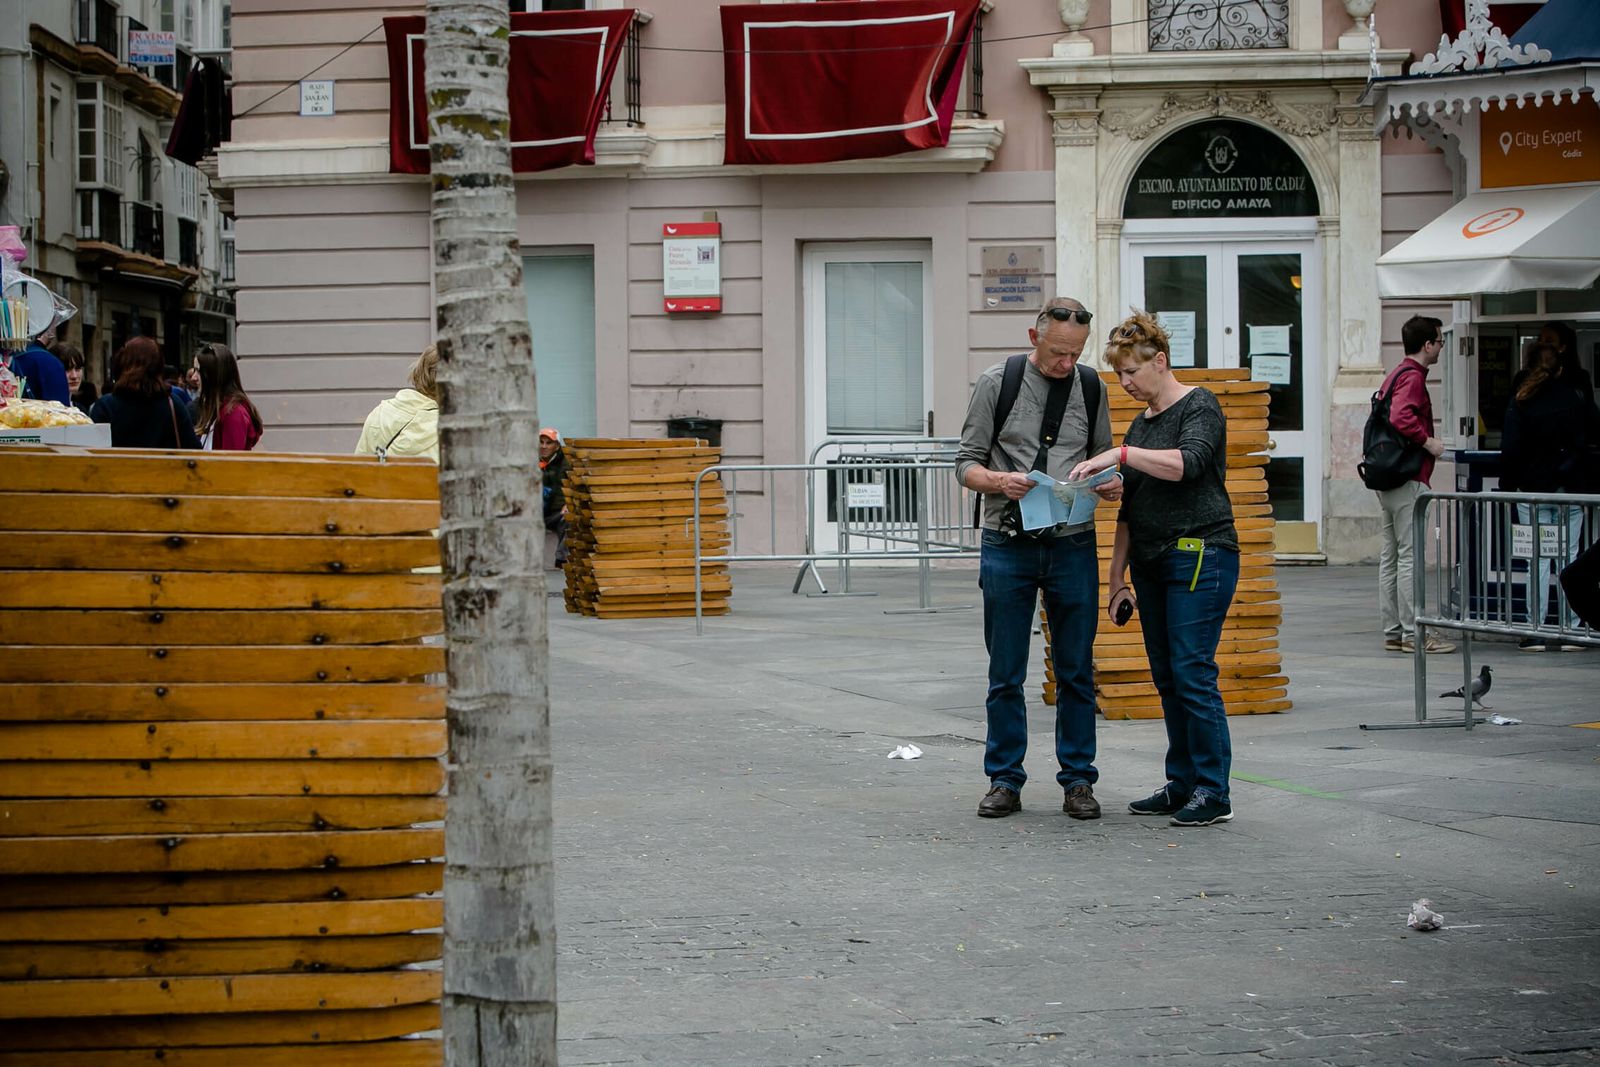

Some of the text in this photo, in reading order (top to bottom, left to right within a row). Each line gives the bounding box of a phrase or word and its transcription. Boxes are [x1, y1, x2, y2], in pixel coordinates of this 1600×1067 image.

[144, 32, 174, 40] VENTA
[1515, 129, 1582, 149] City Expert
[1138, 178, 1175, 193] EXCMO.
[1177, 176, 1258, 193] AYUNTAMIENTO
[1259, 176, 1272, 191] DE
[1171, 198, 1272, 210] EDIFICIO AMAYA
